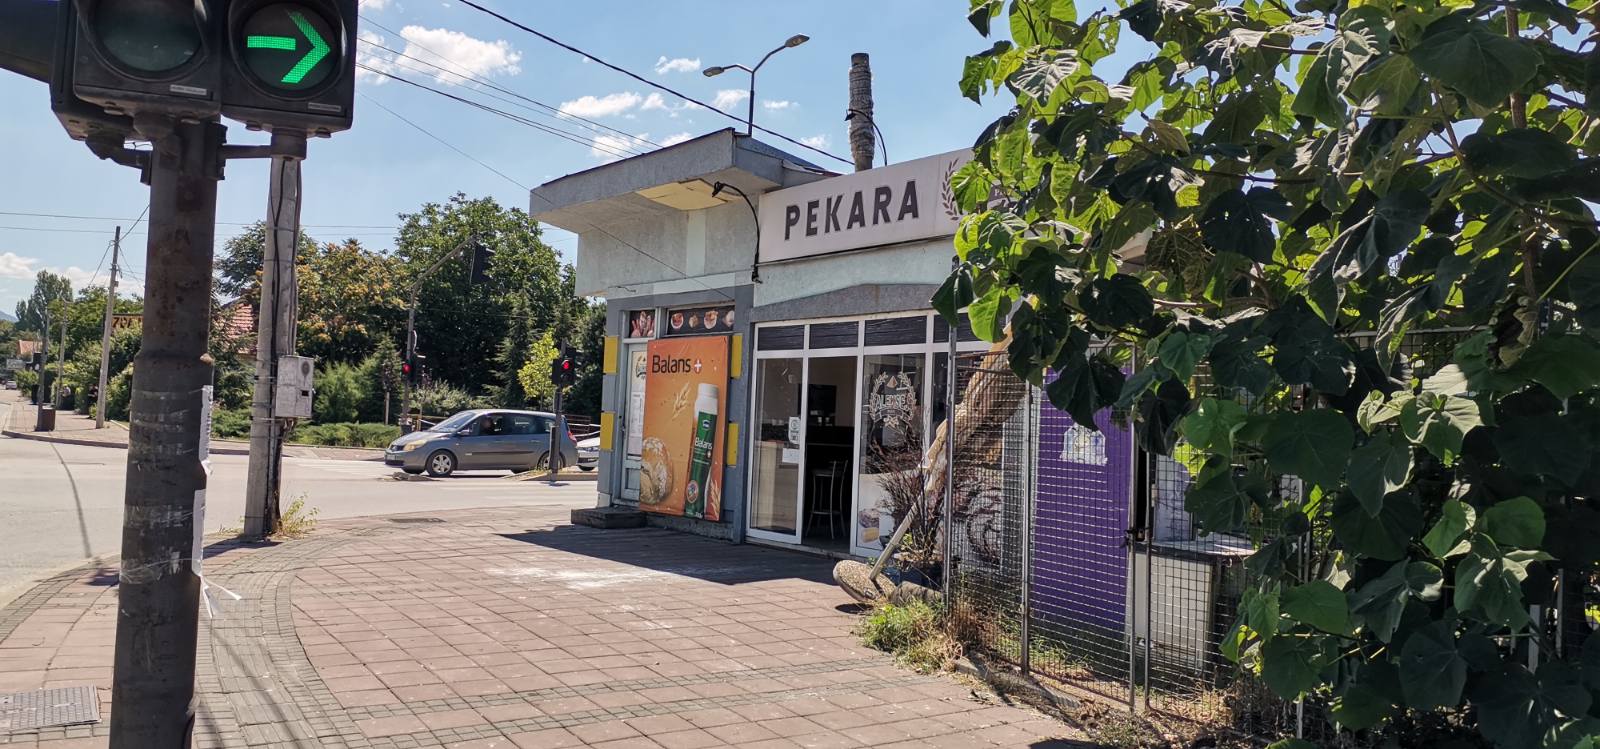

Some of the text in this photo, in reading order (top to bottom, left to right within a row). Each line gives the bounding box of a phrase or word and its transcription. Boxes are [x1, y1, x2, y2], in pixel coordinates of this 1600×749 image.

[784, 180, 919, 241] PEKARA
[652, 354, 691, 374] Balans
[694, 436, 713, 450] Balans
